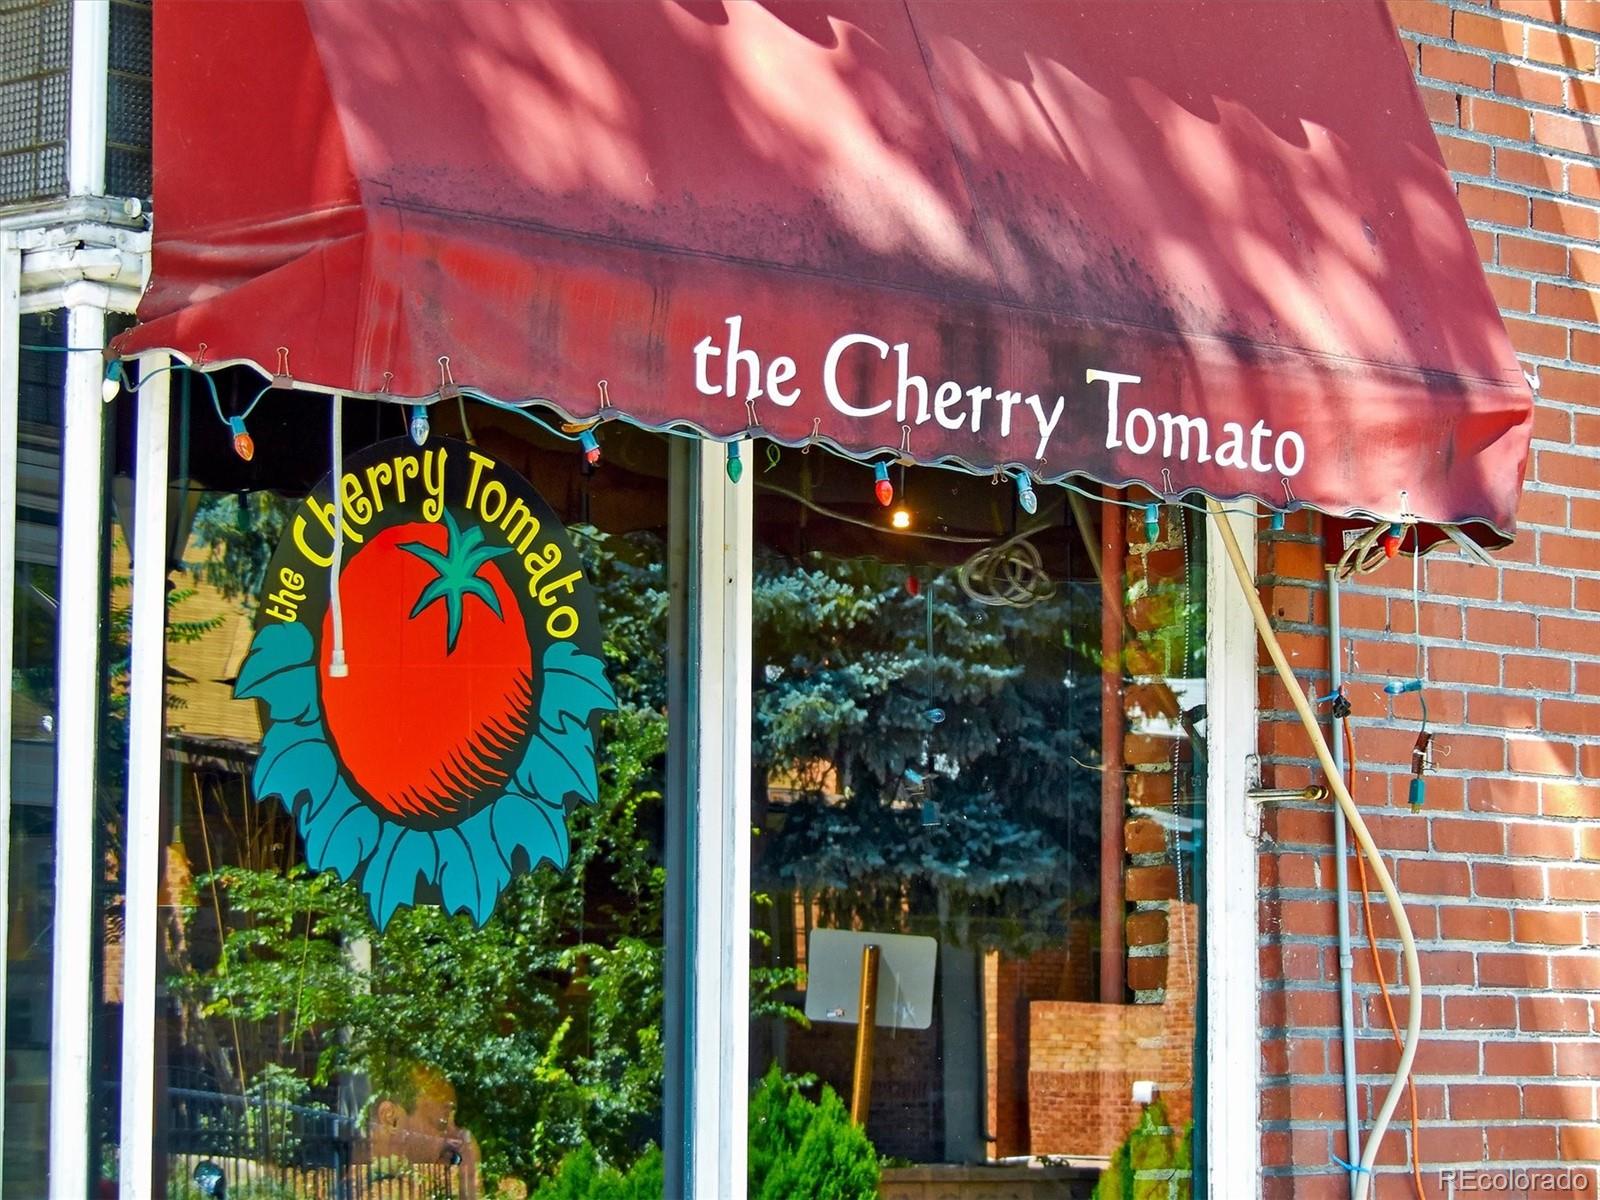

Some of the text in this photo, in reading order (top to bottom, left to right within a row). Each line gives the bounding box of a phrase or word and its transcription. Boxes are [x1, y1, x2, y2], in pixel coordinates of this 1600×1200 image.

[693, 315, 1306, 478] the Cherry Tomato
[265, 446, 584, 639] the Cherry Tomato
